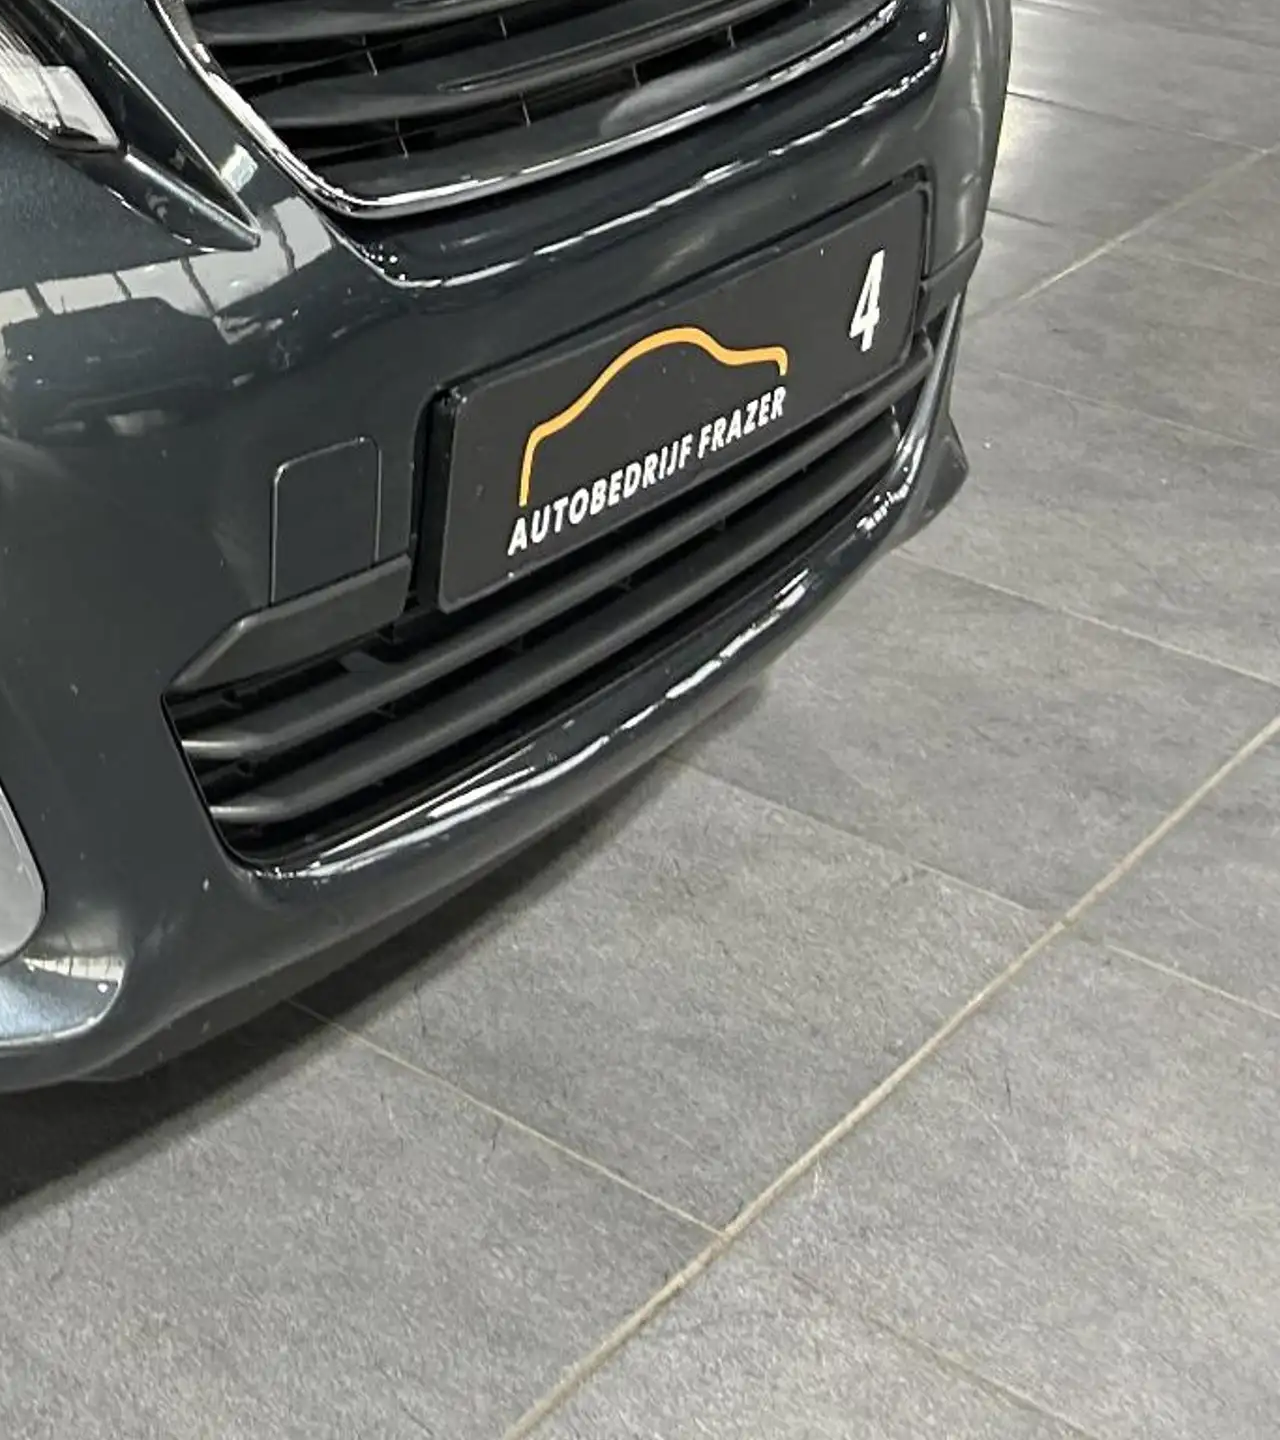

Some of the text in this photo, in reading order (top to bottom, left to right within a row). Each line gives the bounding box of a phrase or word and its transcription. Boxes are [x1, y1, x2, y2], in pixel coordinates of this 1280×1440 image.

[849, 249, 885, 352] 4
[507, 386, 787, 556] AUTOBEDRIJF FRAZER
